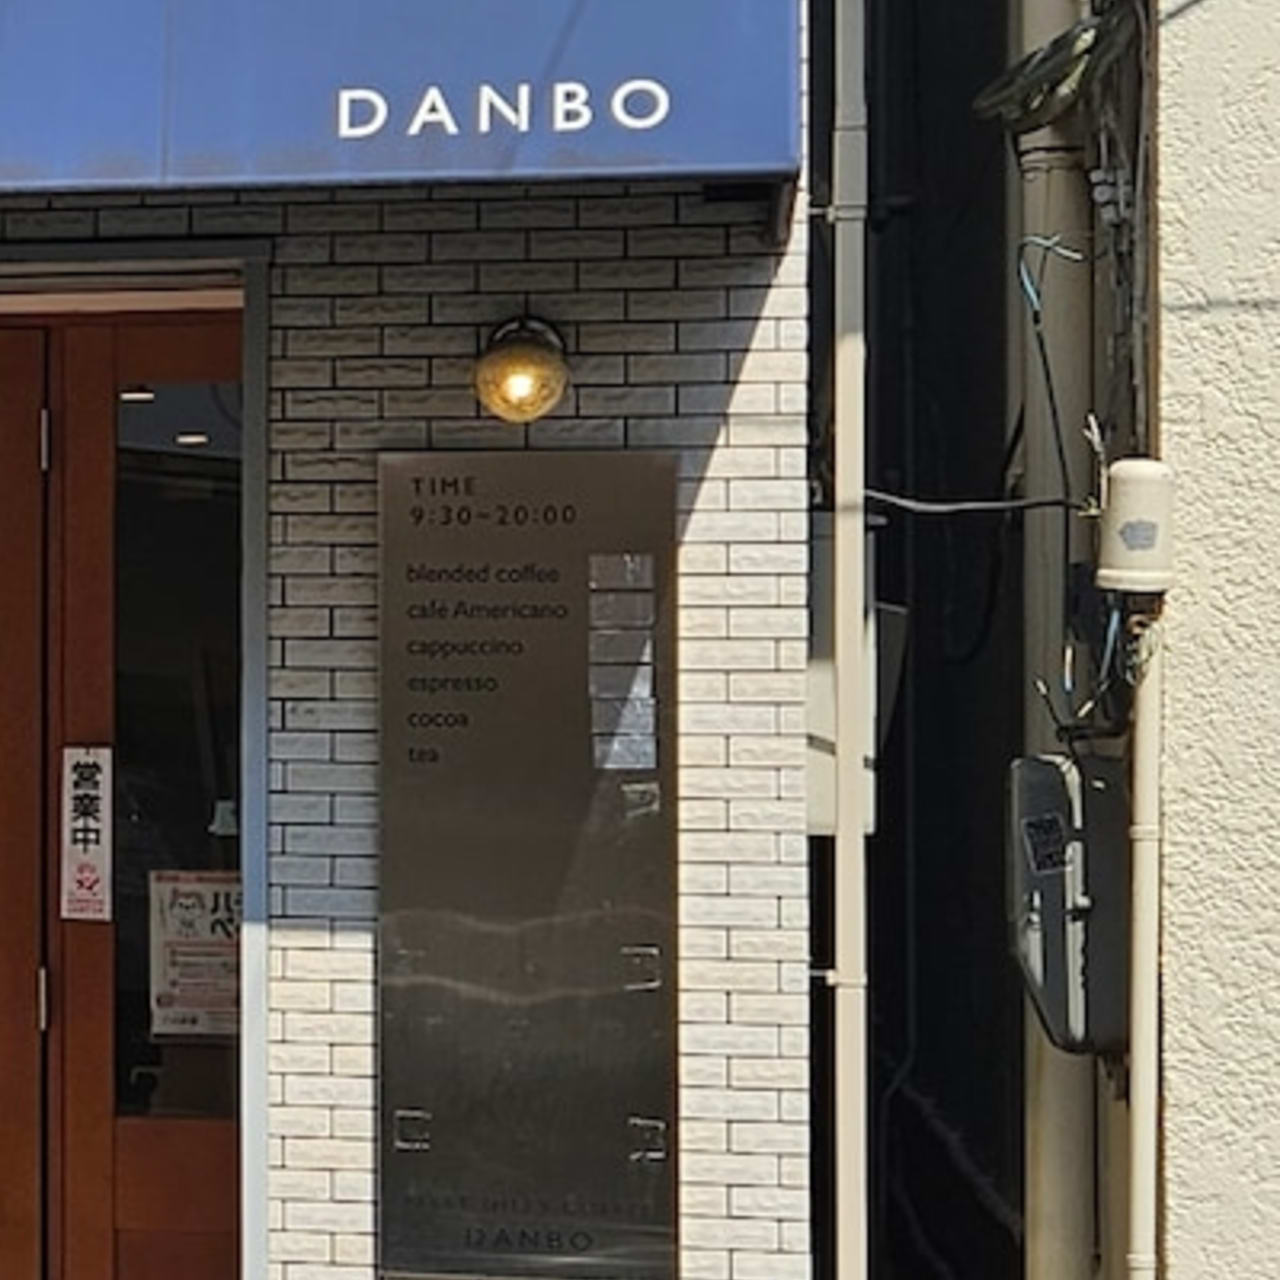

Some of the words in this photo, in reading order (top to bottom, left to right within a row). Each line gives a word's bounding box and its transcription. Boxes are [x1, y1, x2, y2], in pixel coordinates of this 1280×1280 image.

[338, 79, 670, 138] DANBO
[411, 476, 478, 497] TIME
[406, 563, 490, 584] blended
[495, 563, 560, 584] coffee
[452, 600, 569, 620] Americano
[406, 639, 525, 660] cappuccino
[407, 675, 500, 695] espresso
[406, 710, 470, 729] cocoa
[407, 745, 440, 764] tea
[70, 760, 103, 853] 営業中
[463, 1226, 594, 1254] DANBO
